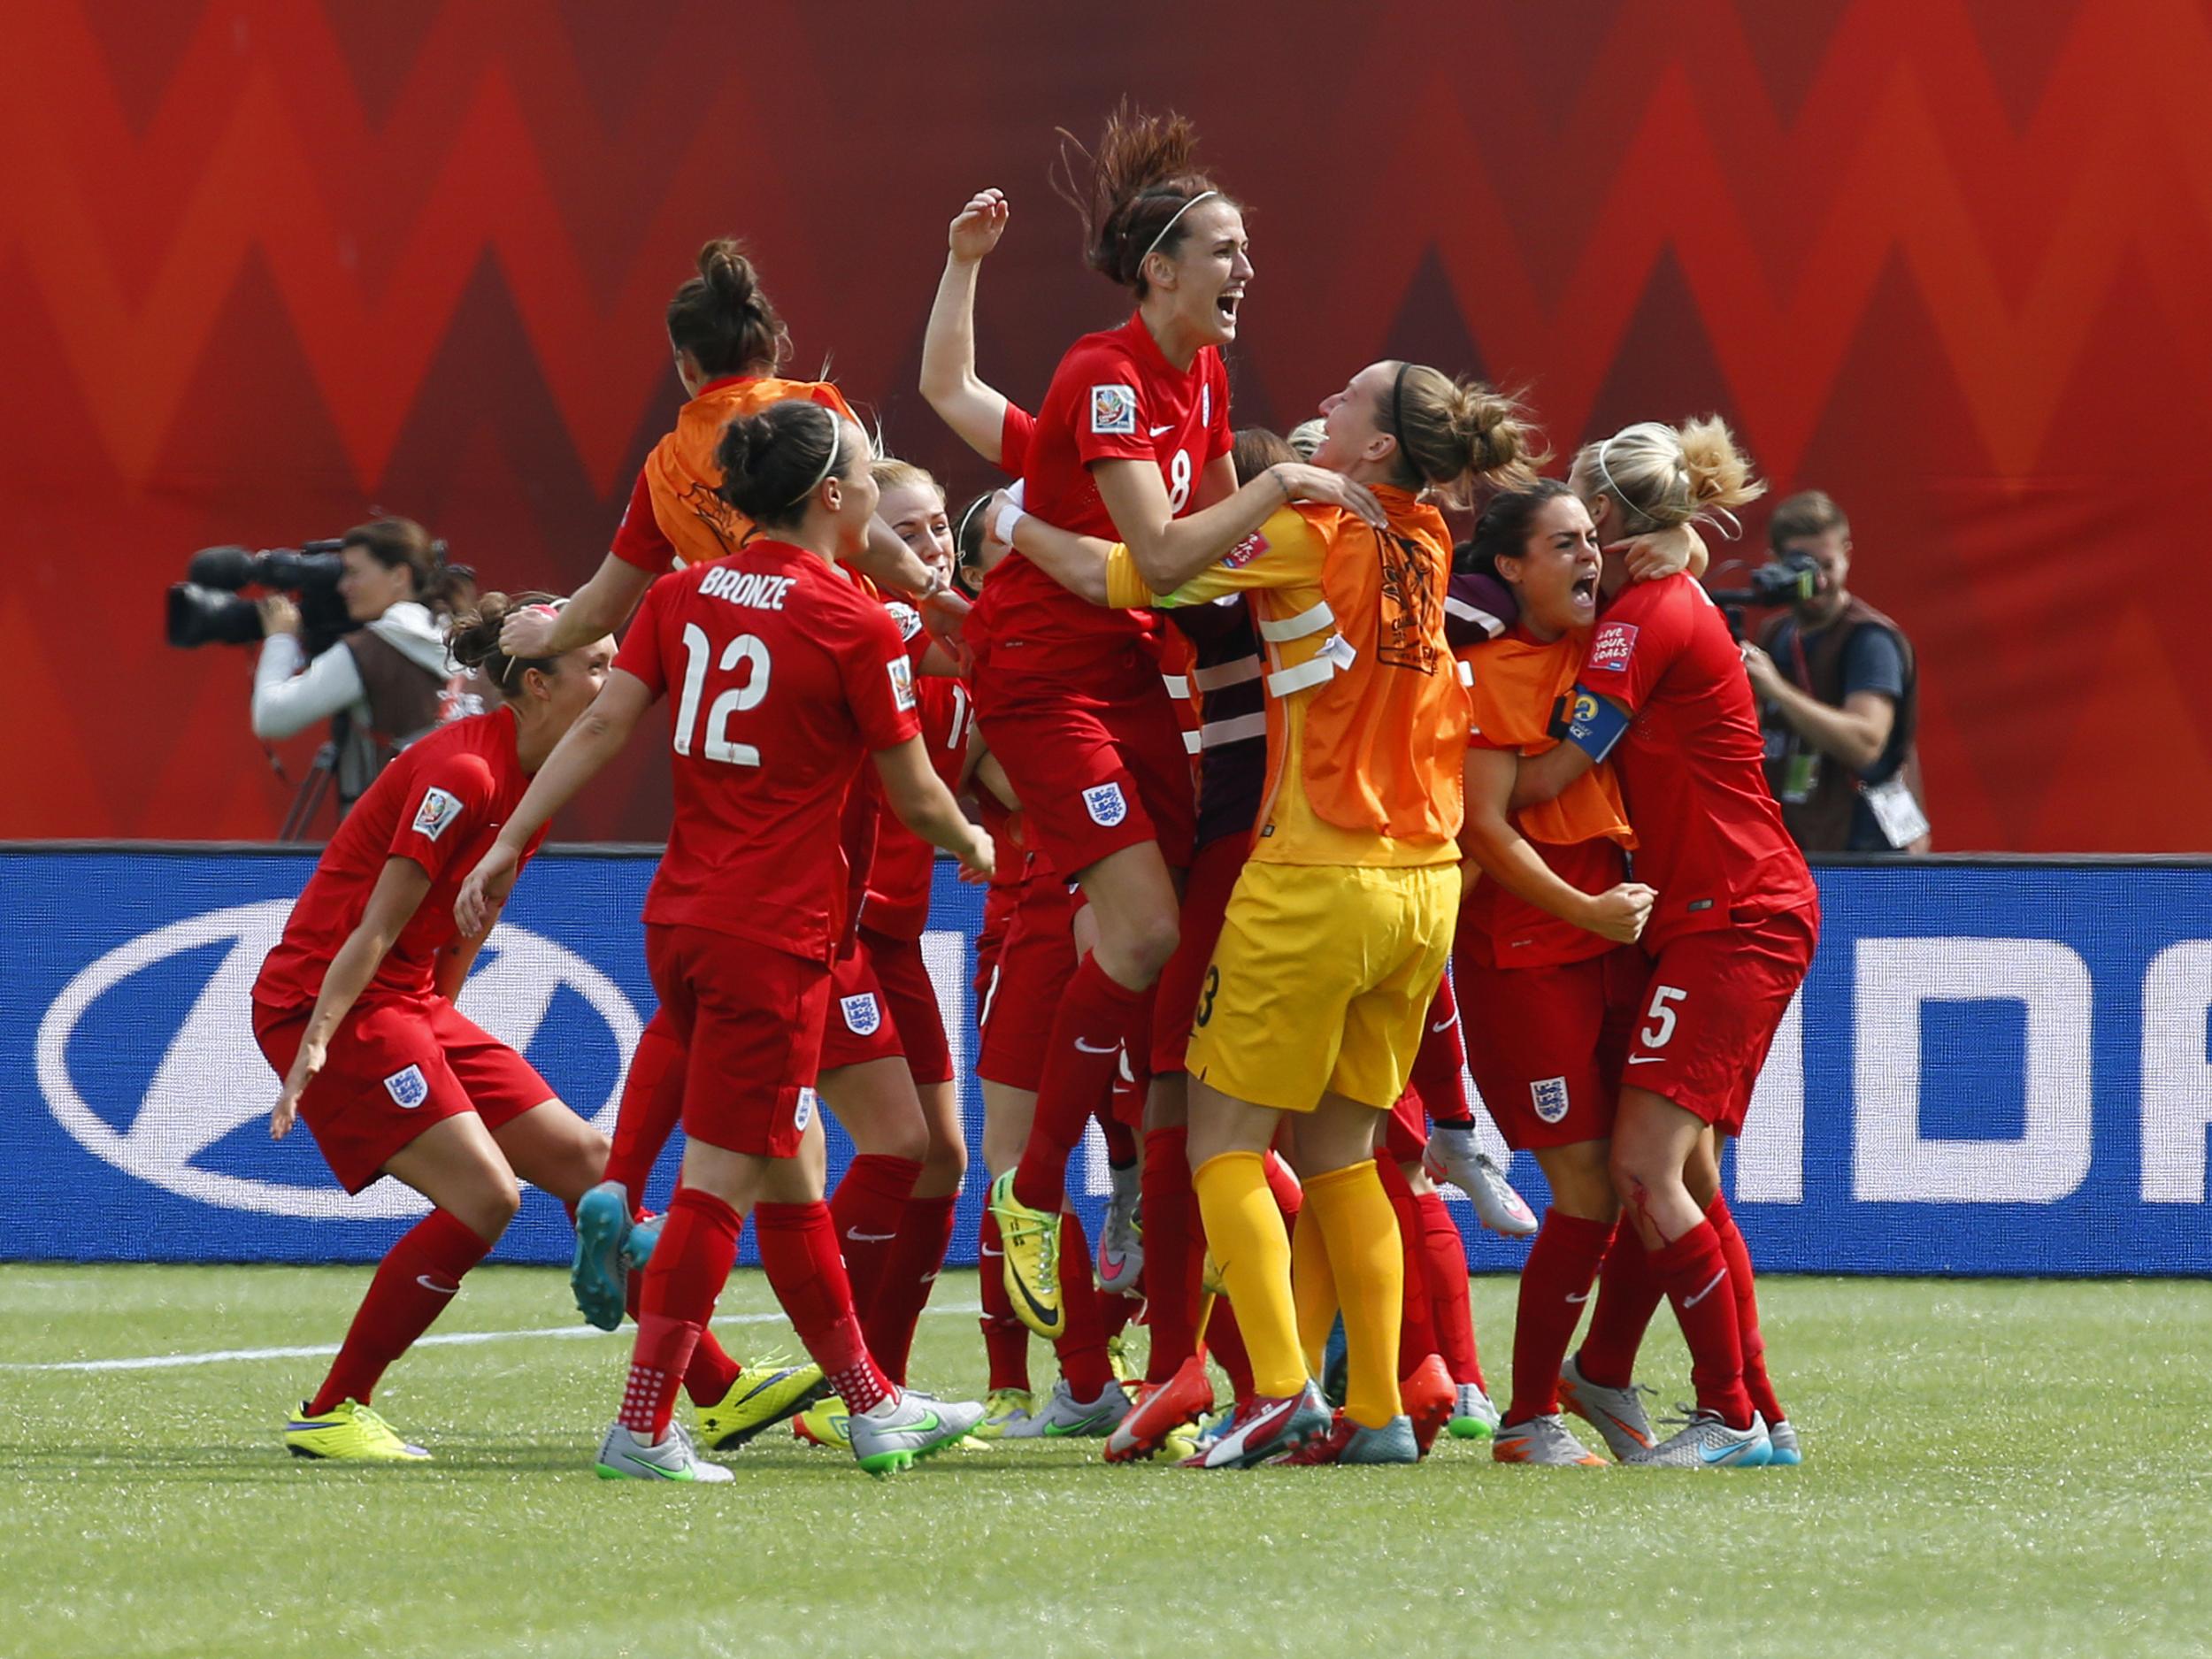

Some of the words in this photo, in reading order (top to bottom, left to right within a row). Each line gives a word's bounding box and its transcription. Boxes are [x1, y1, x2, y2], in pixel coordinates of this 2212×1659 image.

[1170, 448, 1192, 514] 8
[698, 566, 796, 611] BRONZE
[1593, 648, 1628, 662] GOALS
[1596, 638, 1627, 651] YOUR
[673, 622, 771, 767] 12
[1640, 985, 1688, 1048] 5
